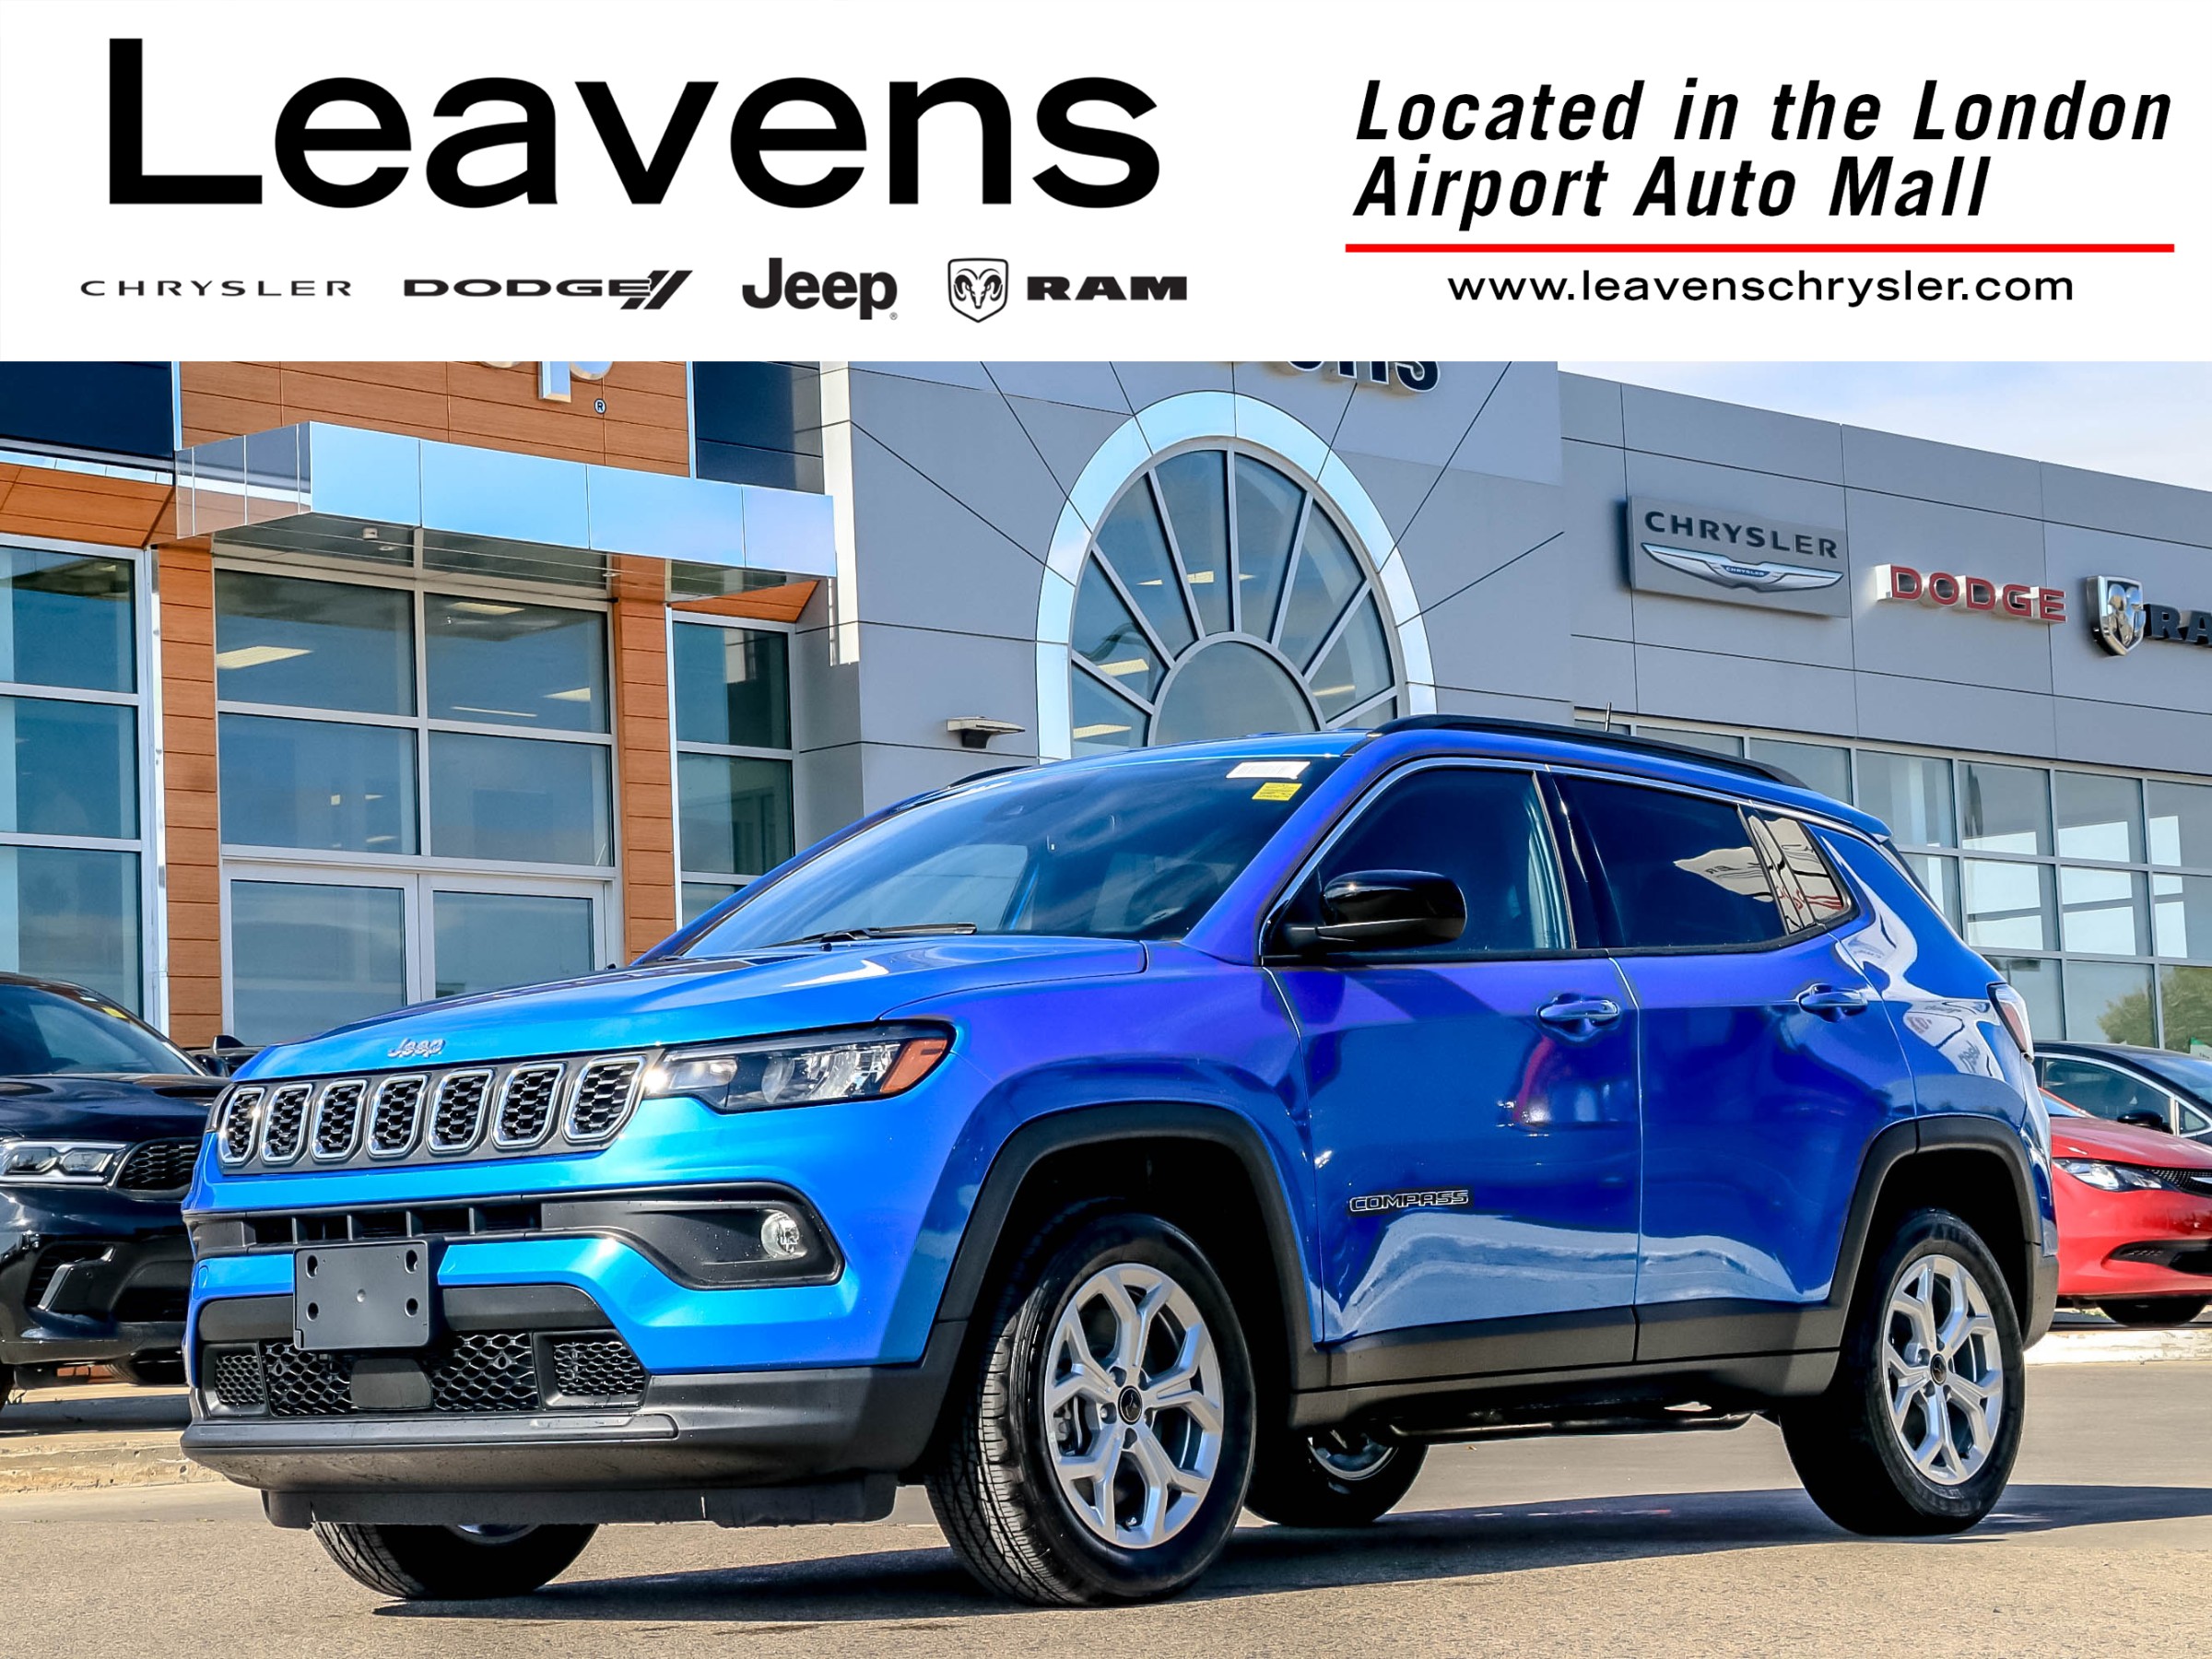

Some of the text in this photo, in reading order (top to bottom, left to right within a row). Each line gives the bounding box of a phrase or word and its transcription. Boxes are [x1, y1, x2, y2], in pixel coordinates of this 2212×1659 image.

[1644, 511, 1838, 559] CHRYSLER
[1889, 564, 2067, 623] DODGE
[387, 1038, 446, 1058] Jeep
[1349, 1189, 1469, 1212] COMPASS
